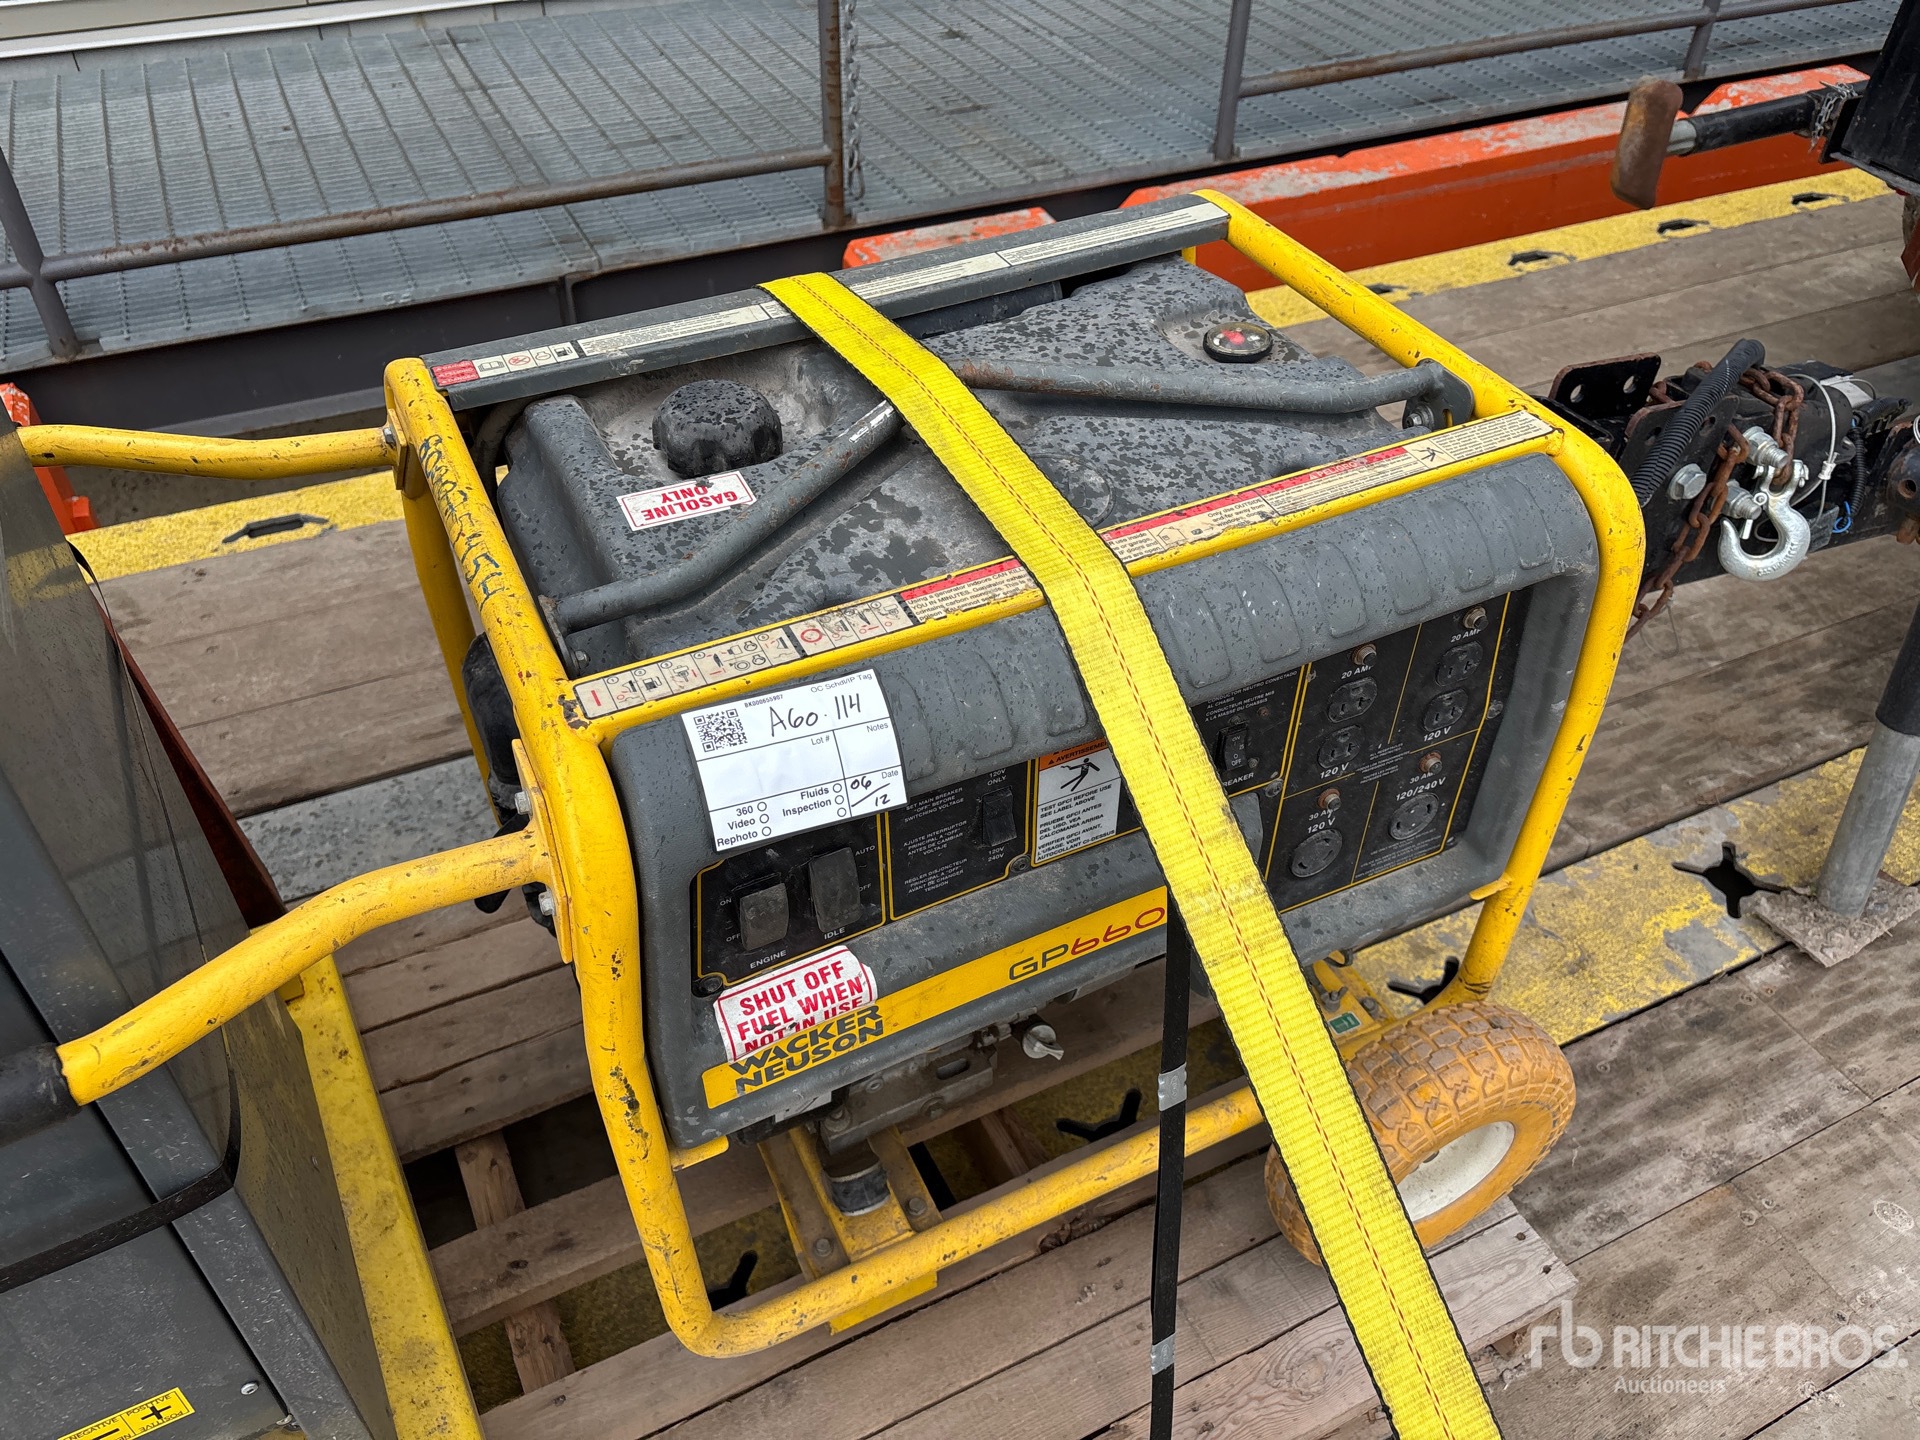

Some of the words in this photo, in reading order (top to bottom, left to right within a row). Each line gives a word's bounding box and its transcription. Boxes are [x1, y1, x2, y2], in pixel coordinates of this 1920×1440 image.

[1317, 461, 1358, 478] PELIGRO
[661, 487, 709, 503] ONLY
[641, 491, 738, 521] GASOLINE
[1128, 532, 1147, 541] inside
[992, 572, 1008, 580] CAN
[1009, 567, 1024, 575] KILL
[946, 597, 969, 607] carbon
[1450, 633, 1462, 643] 20
[810, 685, 824, 693] OC
[858, 673, 873, 682] Tag
[1341, 670, 1353, 680] 20
[1243, 681, 1264, 692] NEUTRO
[1205, 701, 1243, 717] CONDUCTEUR
[1217, 708, 1236, 718] MASSE
[866, 722, 889, 733] Notes
[1423, 730, 1442, 742] 120
[1443, 725, 1452, 735] V
[811, 736, 824, 746] Lot
[1056, 741, 1107, 762] AVERTISSEME
[881, 769, 899, 780] Date
[989, 769, 1006, 778] 120V
[1320, 766, 1339, 779] 120
[1340, 762, 1350, 772] V
[987, 775, 1007, 786] ONLY
[1222, 772, 1254, 787] REAKER
[1409, 775, 1420, 784] 30
[800, 786, 830, 800] Fluids
[906, 803, 918, 811] SET
[918, 797, 934, 806] MAIN
[935, 787, 963, 800] BREAKER
[932, 795, 956, 807] BEFORE
[1040, 803, 1056, 812] TEST
[1057, 798, 1073, 807] GFCI
[1073, 789, 1098, 801] BEFORE
[1099, 784, 1112, 792] USE
[736, 805, 754, 816] 360
[782, 797, 832, 818] Inspection
[904, 807, 938, 823] SWITCHING
[938, 797, 965, 810] VOLTAGE
[1053, 803, 1074, 814] LABEL
[1074, 796, 1096, 806] ABOVE
[1040, 816, 1065, 828] PRUEBE
[1066, 811, 1081, 819] GFCI
[1081, 803, 1103, 814] ANTES
[1308, 812, 1319, 821] 30
[727, 817, 756, 831] Video
[1039, 823, 1080, 841] CALCOMANIA
[1081, 814, 1104, 825] ARRIBA
[1040, 827, 1052, 835] DEL
[1069, 816, 1082, 824] VEA
[1307, 821, 1326, 834] 120
[1328, 817, 1336, 826] V
[716, 830, 758, 847] Rephoto
[903, 835, 926, 847] AJUSTE
[926, 820, 967, 838] INTERRUPTOR
[1038, 836, 1065, 850] VERIFIER
[1066, 831, 1081, 839] GFCI
[1066, 836, 1081, 846] VOIR
[855, 845, 876, 856] AUTO
[907, 836, 938, 850] PRINCIPAL
[907, 845, 927, 856] ANTES
[936, 832, 964, 845] CAMBIAR
[923, 844, 948, 855] VOLTAJE
[988, 846, 1005, 855] 120V
[987, 853, 1005, 862] 240V
[1037, 842, 1082, 861] AUTOCOLLANT
[928, 858, 968, 875] DISJONCTEUR
[908, 883, 927, 894] AVANT
[936, 869, 964, 883] CHANGER
[910, 874, 940, 887] PRINCIPAL
[924, 881, 949, 893] TENSION
[719, 897, 732, 906] ON
[726, 932, 741, 942] OFF
[824, 926, 846, 940] IDLE
[750, 950, 787, 969] ENGINE
[739, 979, 798, 1016] SHUT
[803, 960, 844, 990] OFF
[737, 1006, 794, 1041] FUEL
[797, 976, 864, 1015] WHEN
[744, 1028, 786, 1053] NOT
[795, 1016, 816, 1033] IN
[824, 996, 863, 1020] USE
[729, 1005, 883, 1076] WACKER
[735, 1020, 884, 1097] NEUSON
[126, 1394, 172, 1417] POSITIVE
[139, 1411, 184, 1432] POSITIVE
